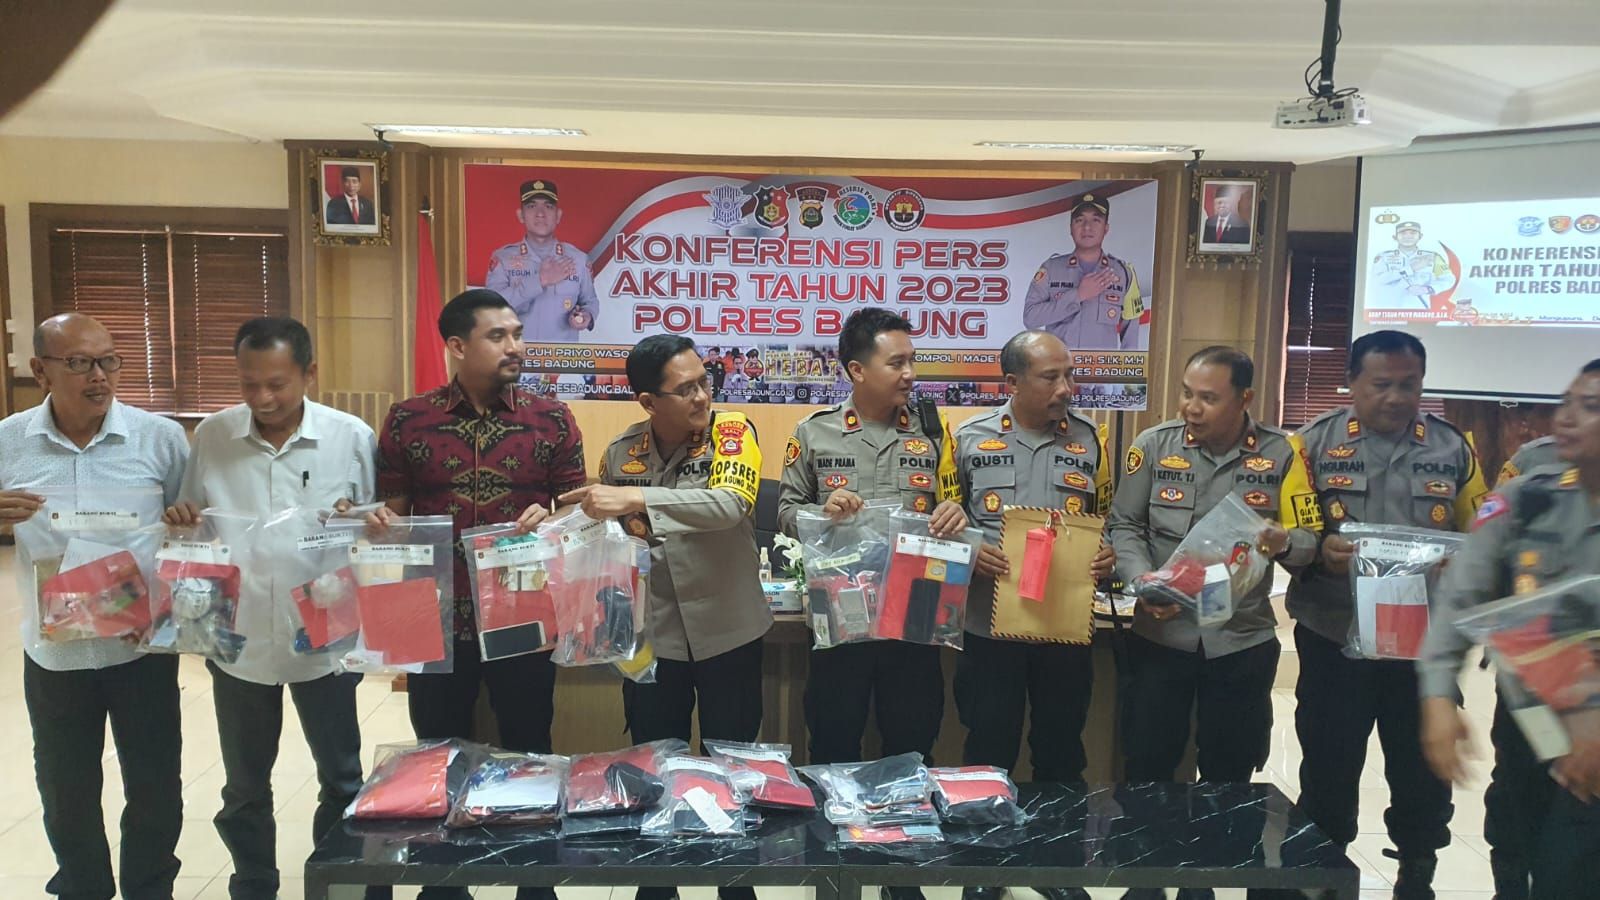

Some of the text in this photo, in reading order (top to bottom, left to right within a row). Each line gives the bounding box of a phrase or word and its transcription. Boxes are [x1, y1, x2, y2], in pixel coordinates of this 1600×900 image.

[615, 234, 1008, 269] KONFERENSI PERS
[1469, 263, 1600, 278] AKHIR TAHU
[611, 270, 1009, 303] AKHIR TAHUN 2023
[1495, 280, 1600, 294] POLRES BAD
[634, 305, 988, 339] POLRES BUNG
[526, 347, 630, 359] GUH PRIYO WASO
[963, 354, 995, 363] MADE
[544, 359, 595, 369] BADUNG
[765, 359, 839, 377] HEBAT
[1094, 367, 1143, 376] BADUNG
[899, 457, 935, 469] POLRI
[972, 454, 1014, 467] GUSTI
[1055, 455, 1094, 474] POLRI
[1412, 462, 1457, 475] POLRI
[1235, 474, 1280, 485] POLRI
